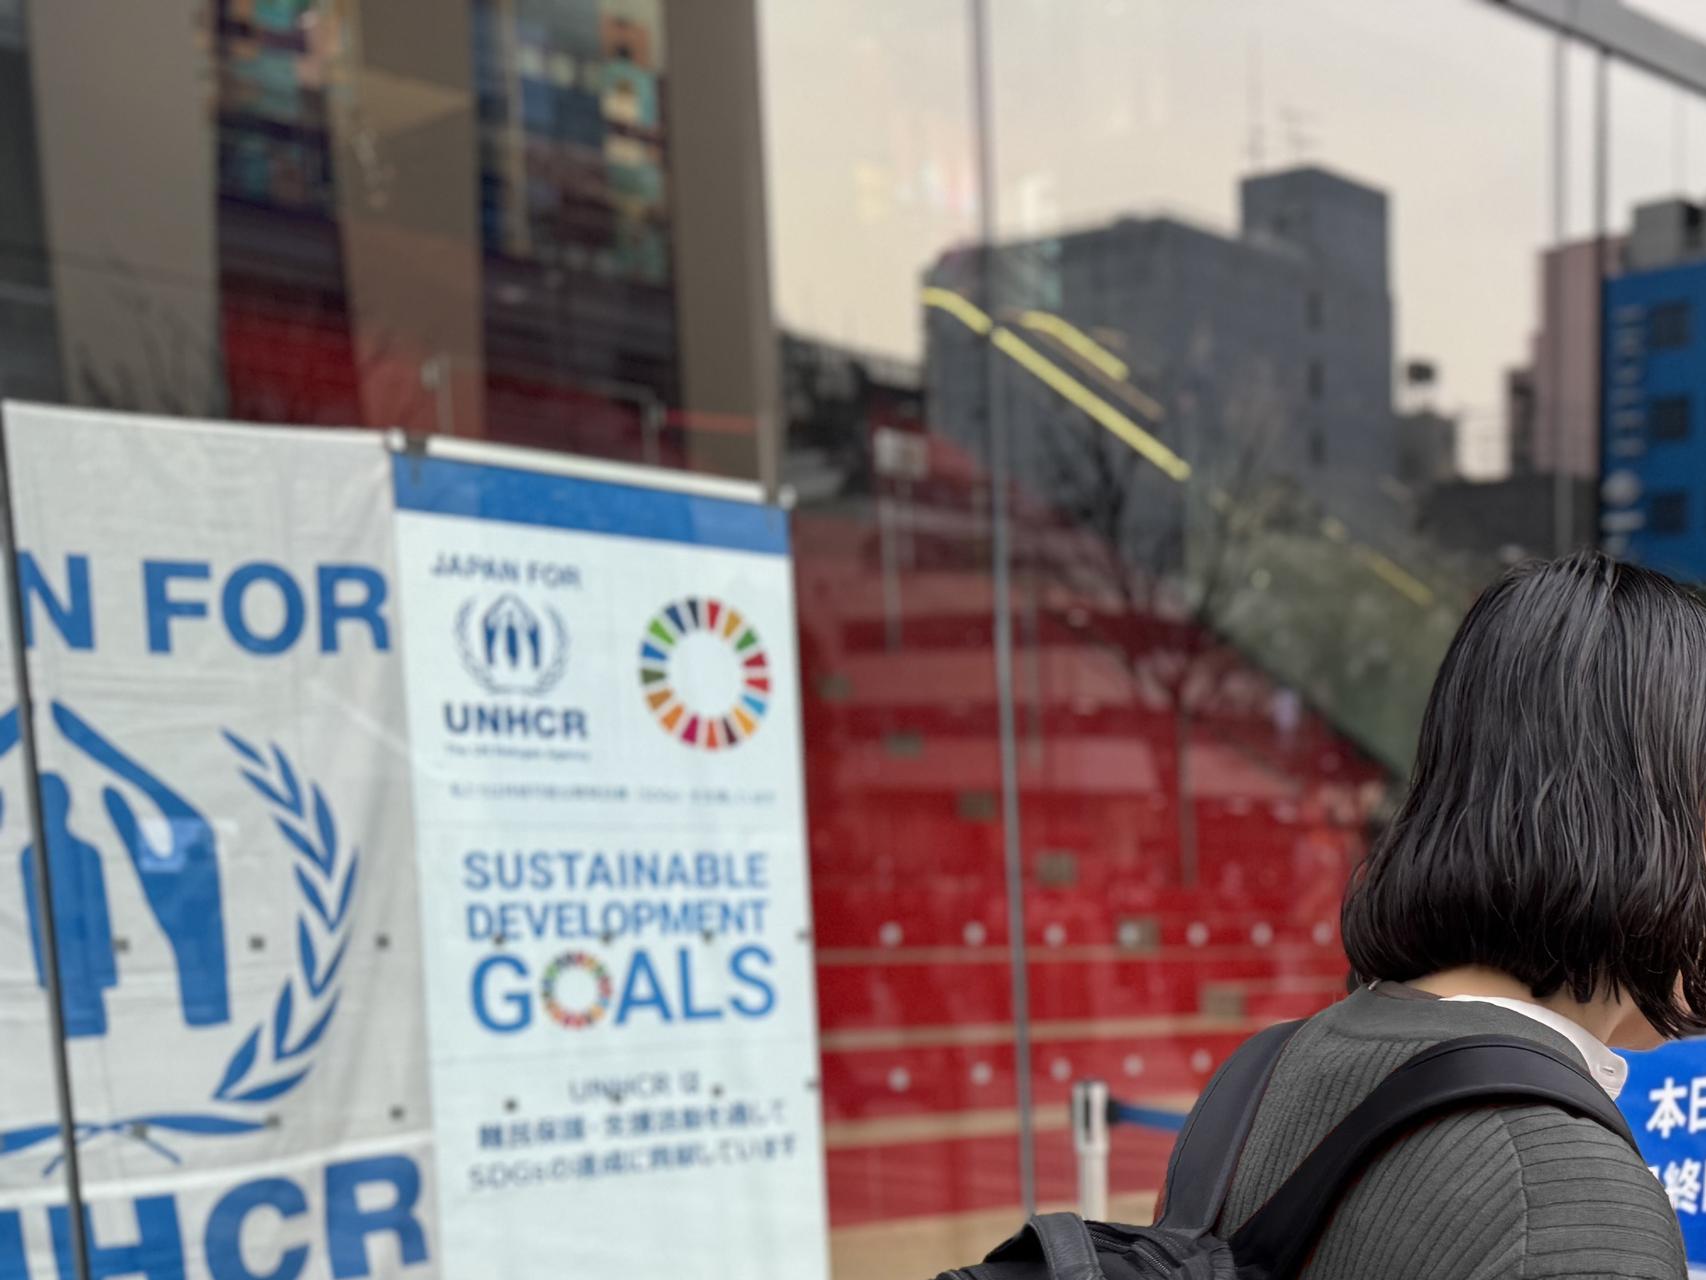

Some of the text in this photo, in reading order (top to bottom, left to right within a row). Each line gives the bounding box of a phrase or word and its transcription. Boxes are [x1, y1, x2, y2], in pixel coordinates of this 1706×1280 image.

[525, 560, 582, 590] FOR
[142, 560, 392, 656] FOR
[443, 702, 588, 738] UNHCR
[463, 851, 770, 891] SUSTAINABLE
[466, 898, 770, 942] DEVELOPMENT
[470, 945, 777, 1036] GOALS
